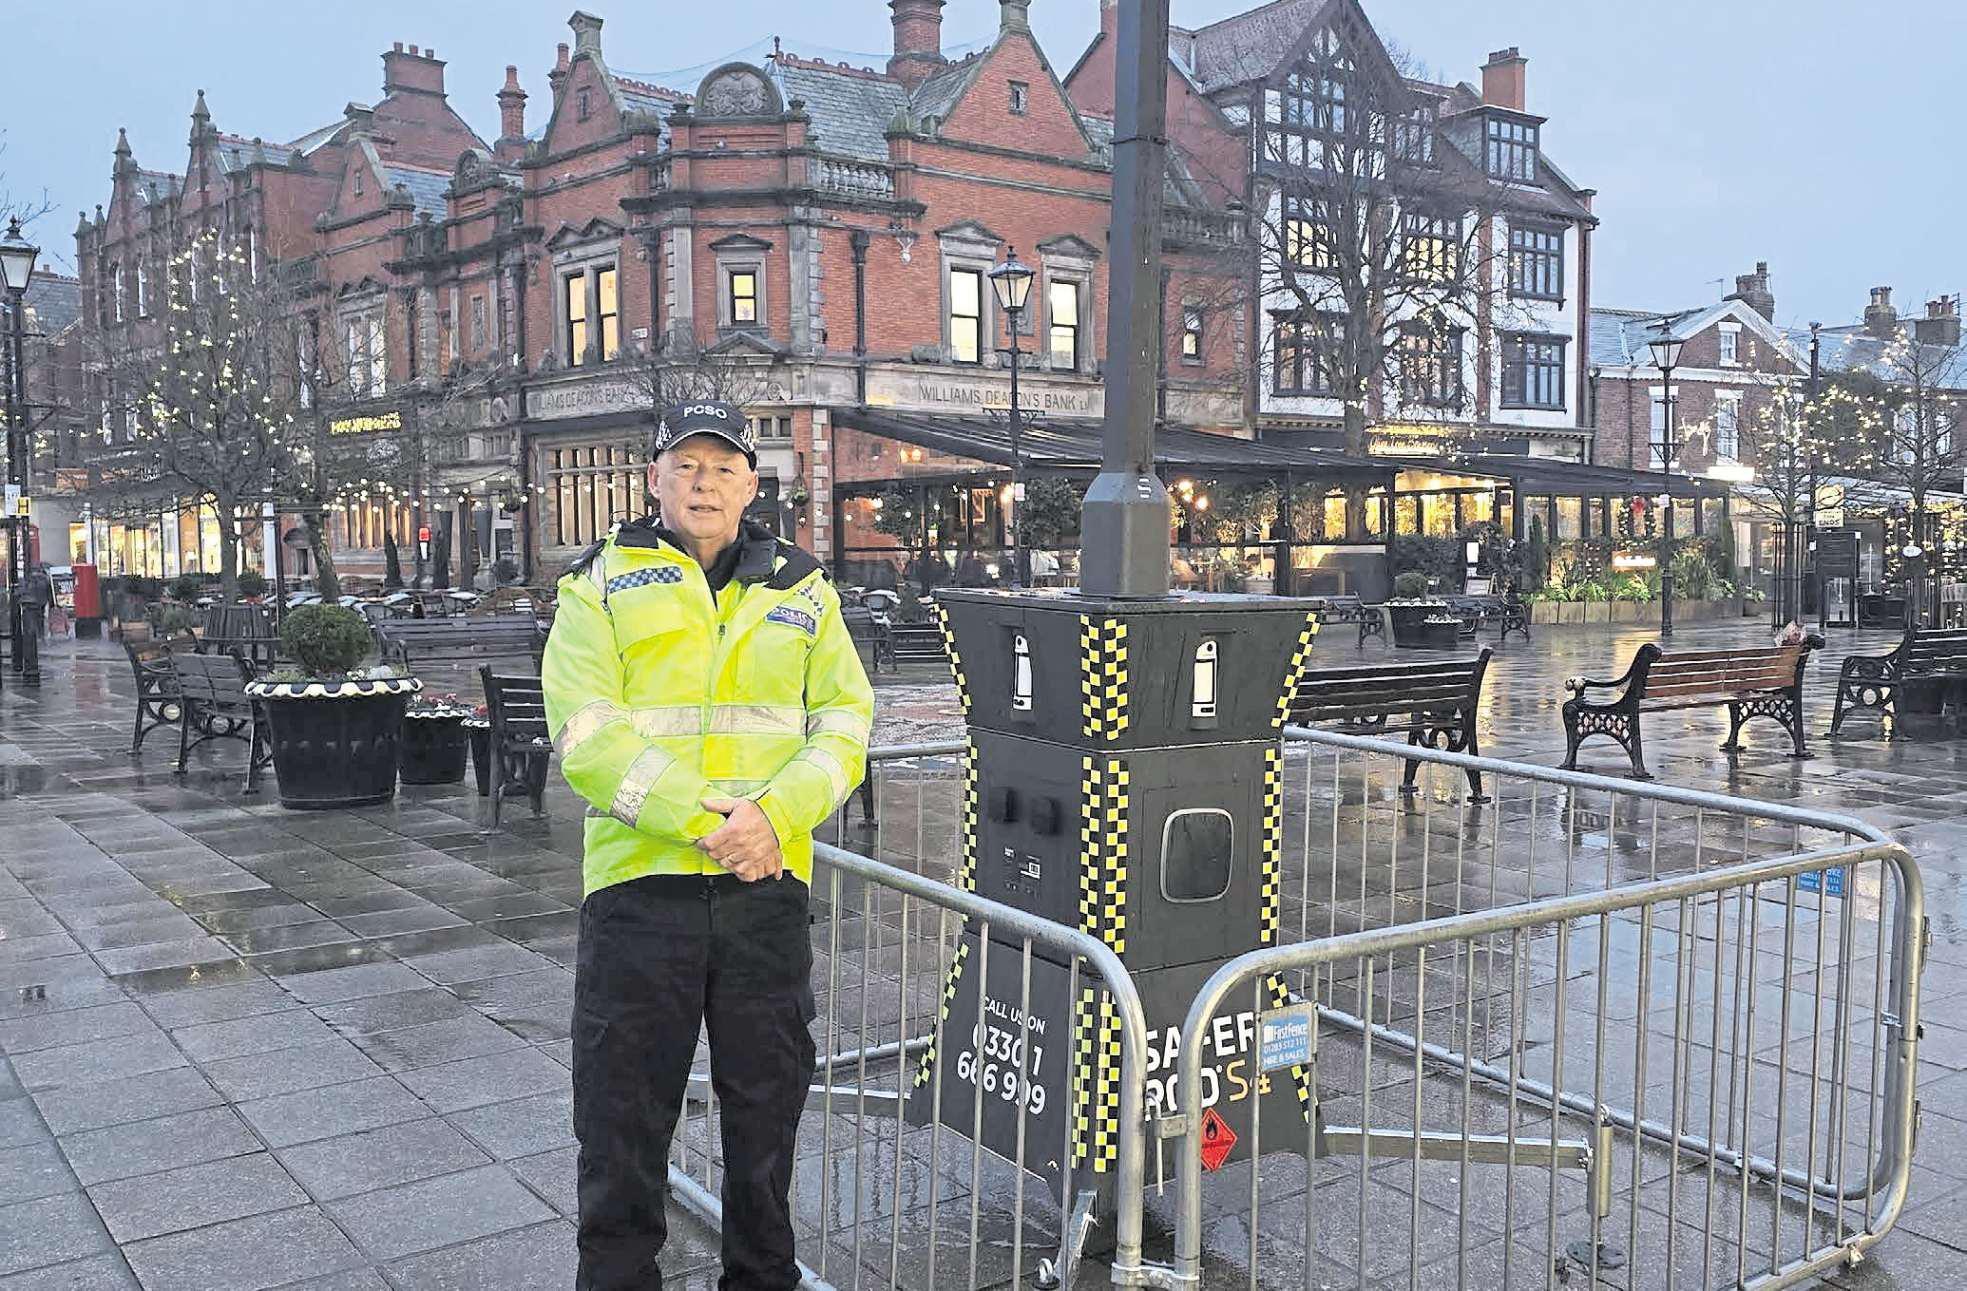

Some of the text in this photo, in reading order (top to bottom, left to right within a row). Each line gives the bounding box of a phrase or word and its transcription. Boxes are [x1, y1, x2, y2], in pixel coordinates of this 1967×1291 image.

[920, 382, 980, 404] WILLIAMS
[1045, 394, 1076, 410] BANK
[683, 404, 728, 420] PCSO
[17, 498, 29, 514] H
[1027, 1015, 1046, 1036] ON
